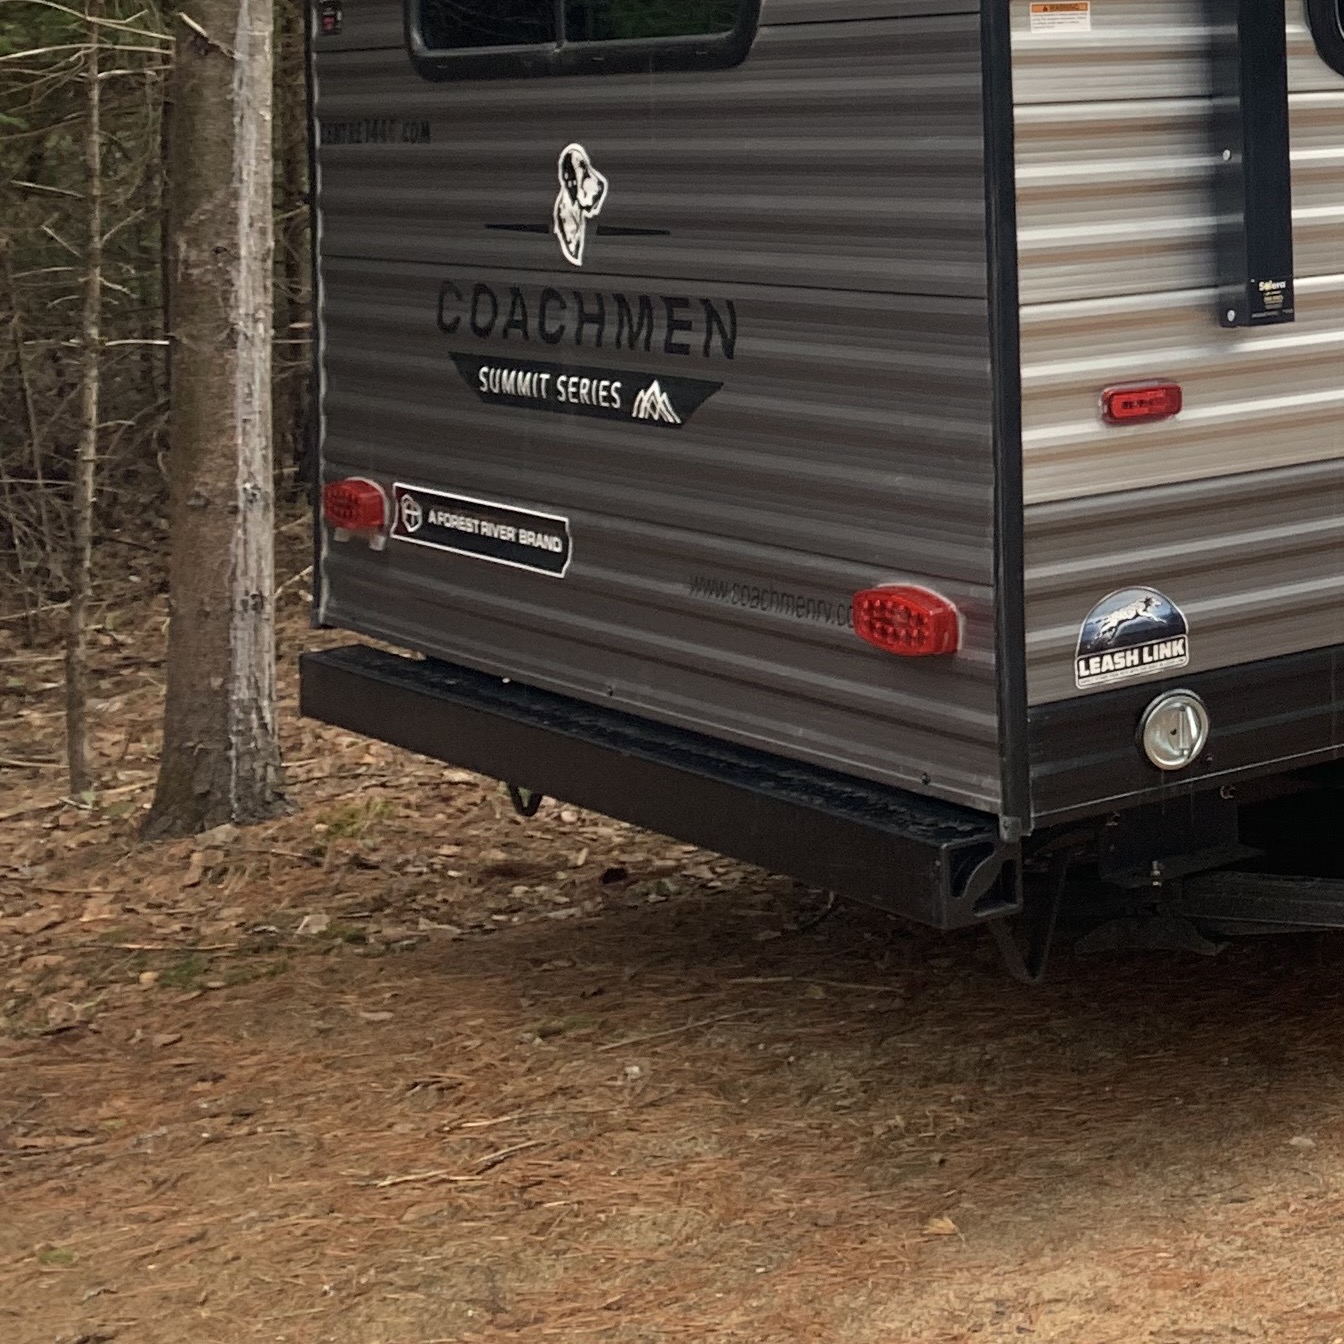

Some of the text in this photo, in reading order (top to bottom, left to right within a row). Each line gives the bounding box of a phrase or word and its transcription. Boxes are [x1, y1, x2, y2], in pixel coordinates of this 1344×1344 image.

[436, 280, 738, 360] COACHMEN
[478, 366, 622, 409] SUMMIT SERIES
[428, 509, 563, 553] A FOREST RIVER BRAND
[1079, 649, 1140, 677] LEASH
[1143, 638, 1185, 664] LINK
